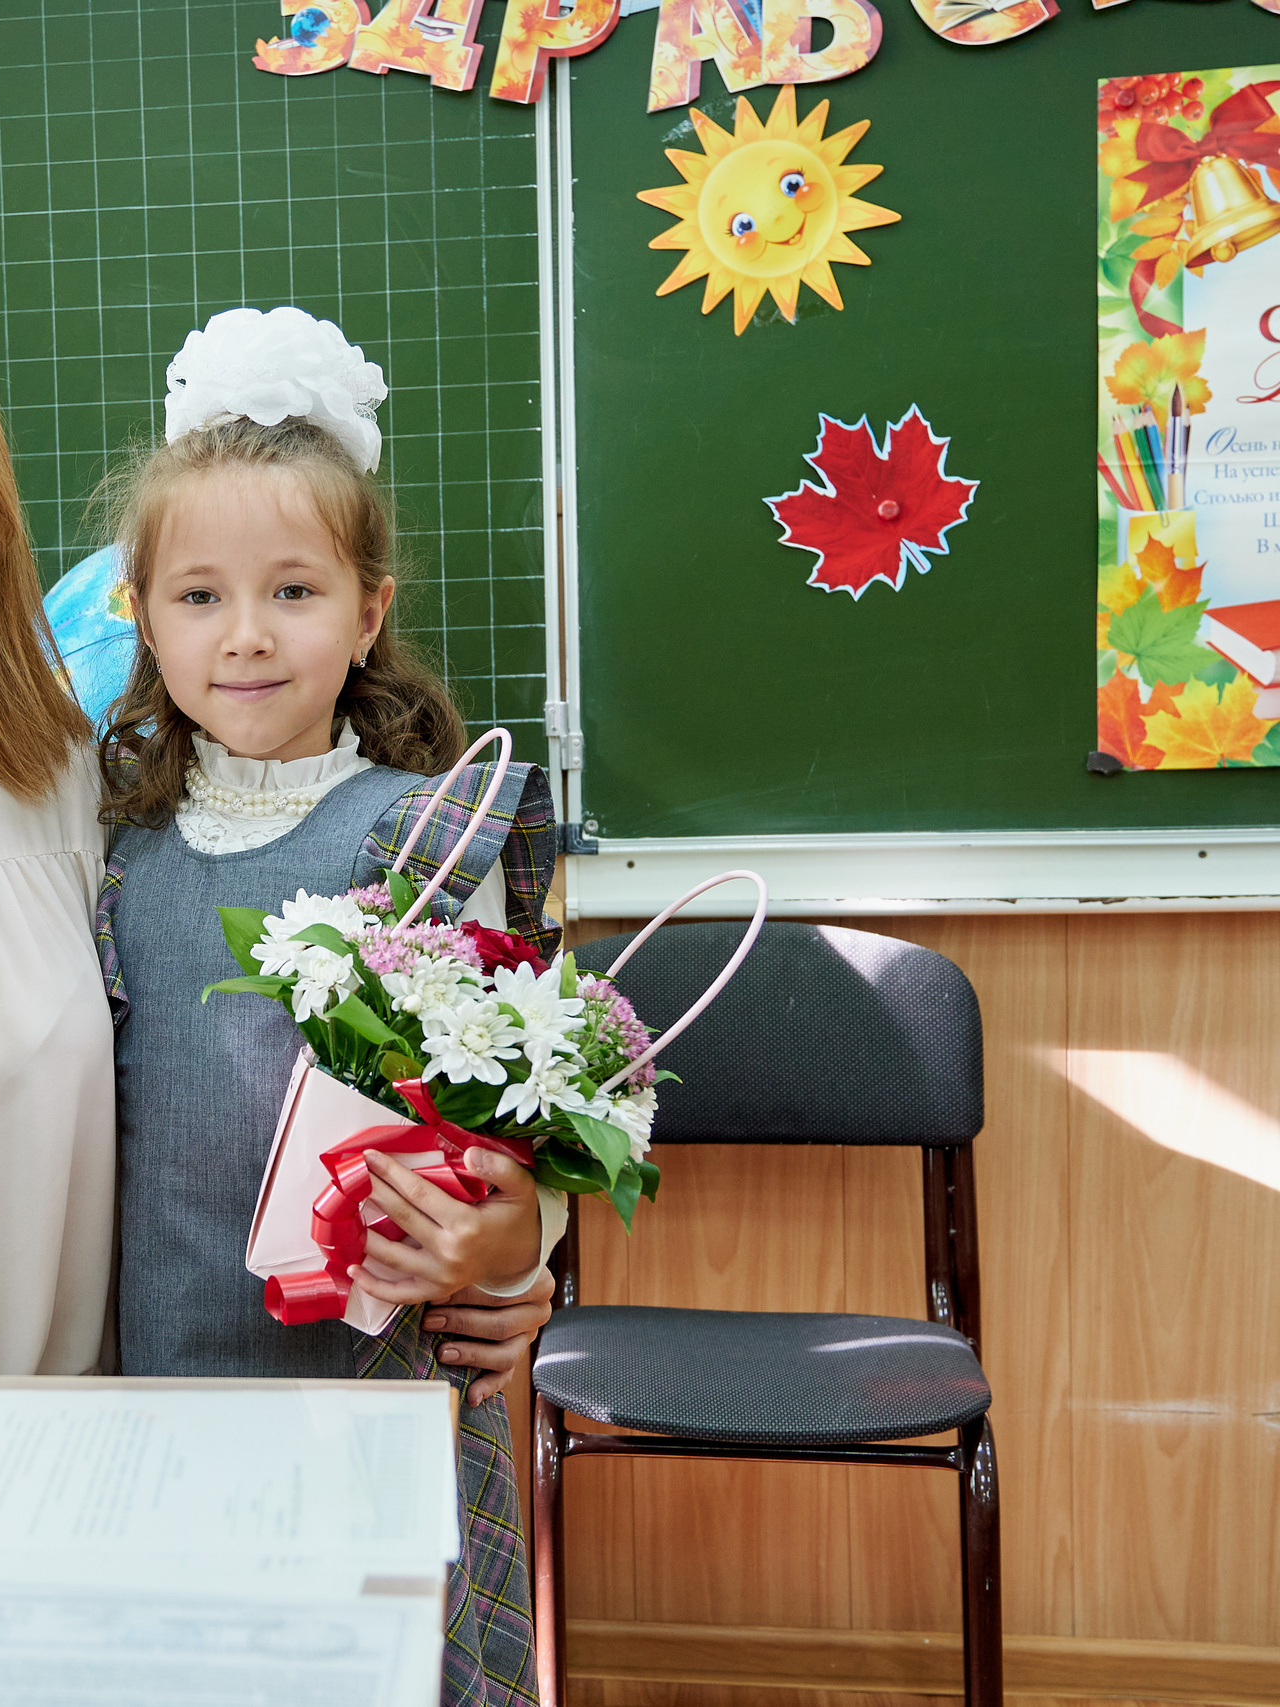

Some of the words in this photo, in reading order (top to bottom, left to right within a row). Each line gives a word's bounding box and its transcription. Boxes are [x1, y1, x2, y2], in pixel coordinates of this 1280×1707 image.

[1205, 425, 1267, 456] Осень
[1214, 463, 1238, 479] На
[1194, 489, 1264, 505] Столько
